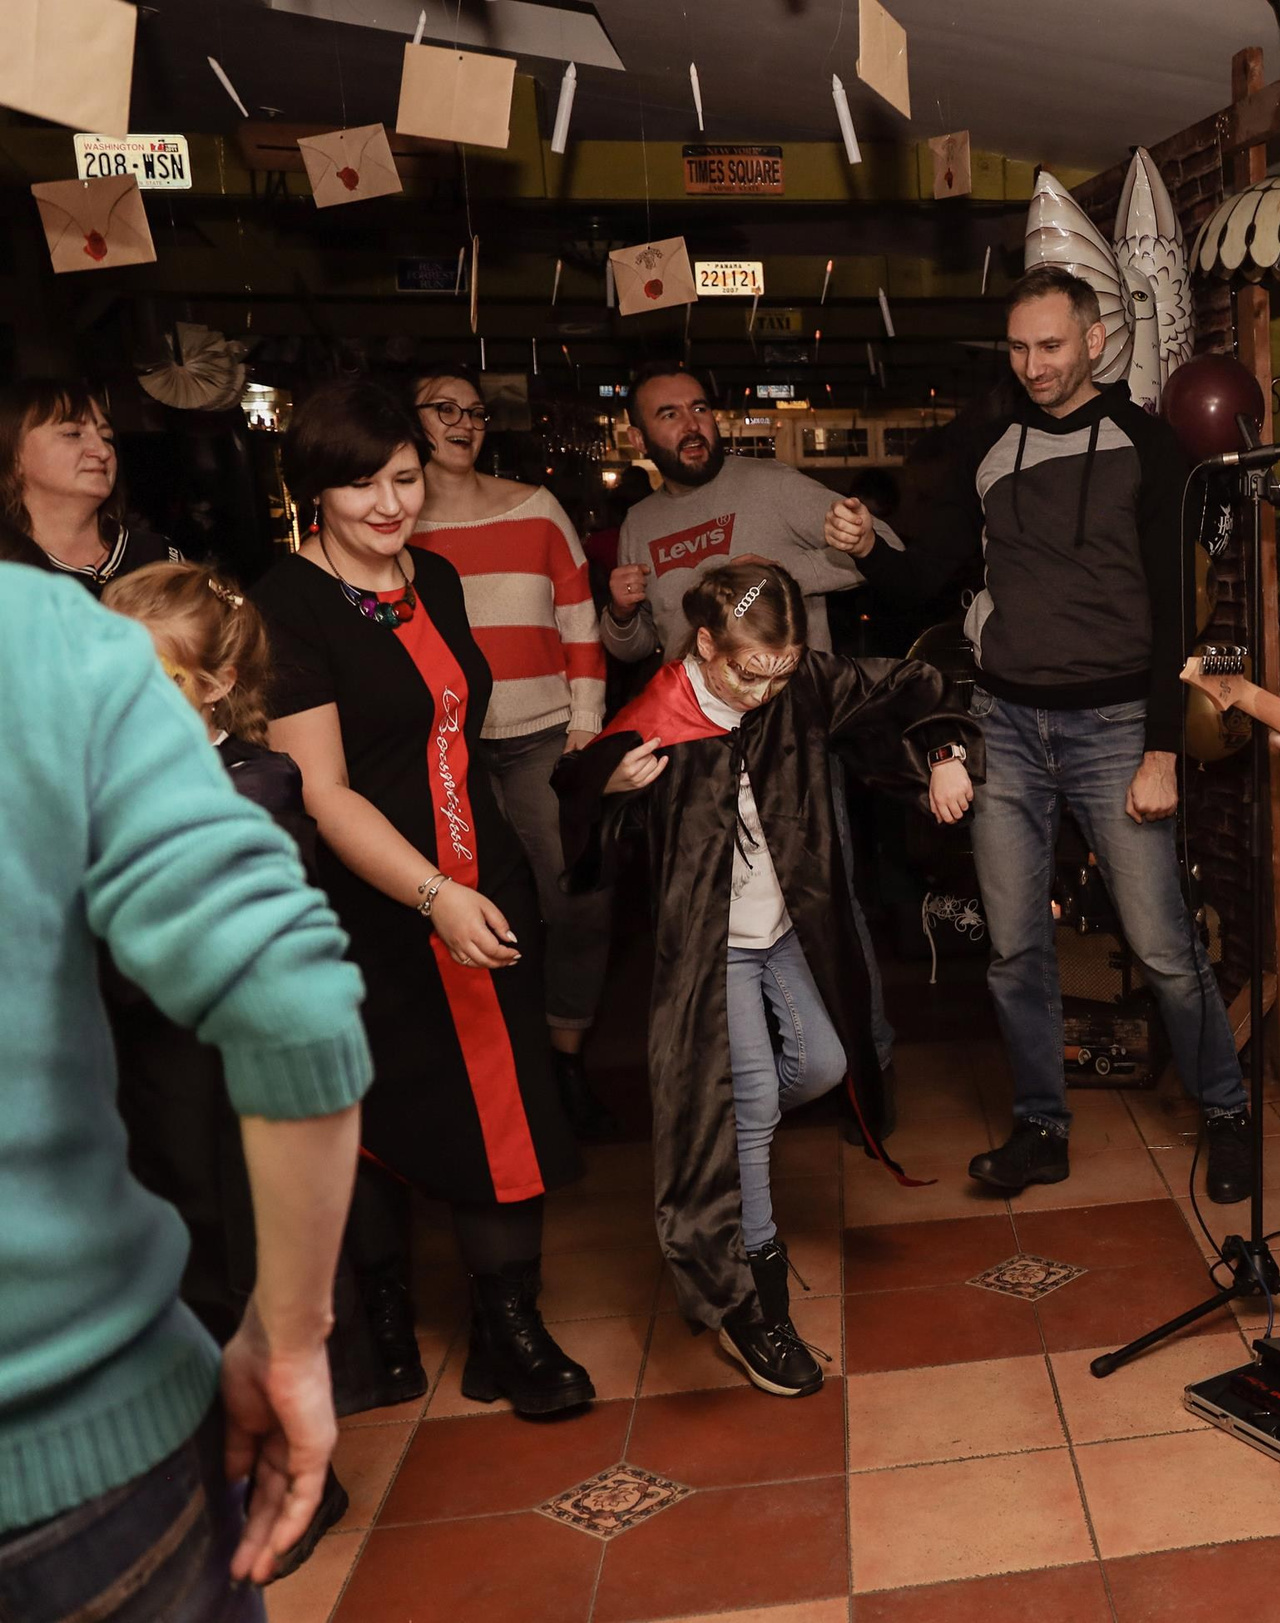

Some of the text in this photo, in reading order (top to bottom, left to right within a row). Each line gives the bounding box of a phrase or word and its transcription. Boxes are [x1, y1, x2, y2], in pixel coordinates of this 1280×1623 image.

[83, 143, 145, 151] WASHINGTON
[687, 160, 780, 183] TIMES SQUARE
[701, 270, 756, 287] 221121
[758, 317, 790, 329] TAXI
